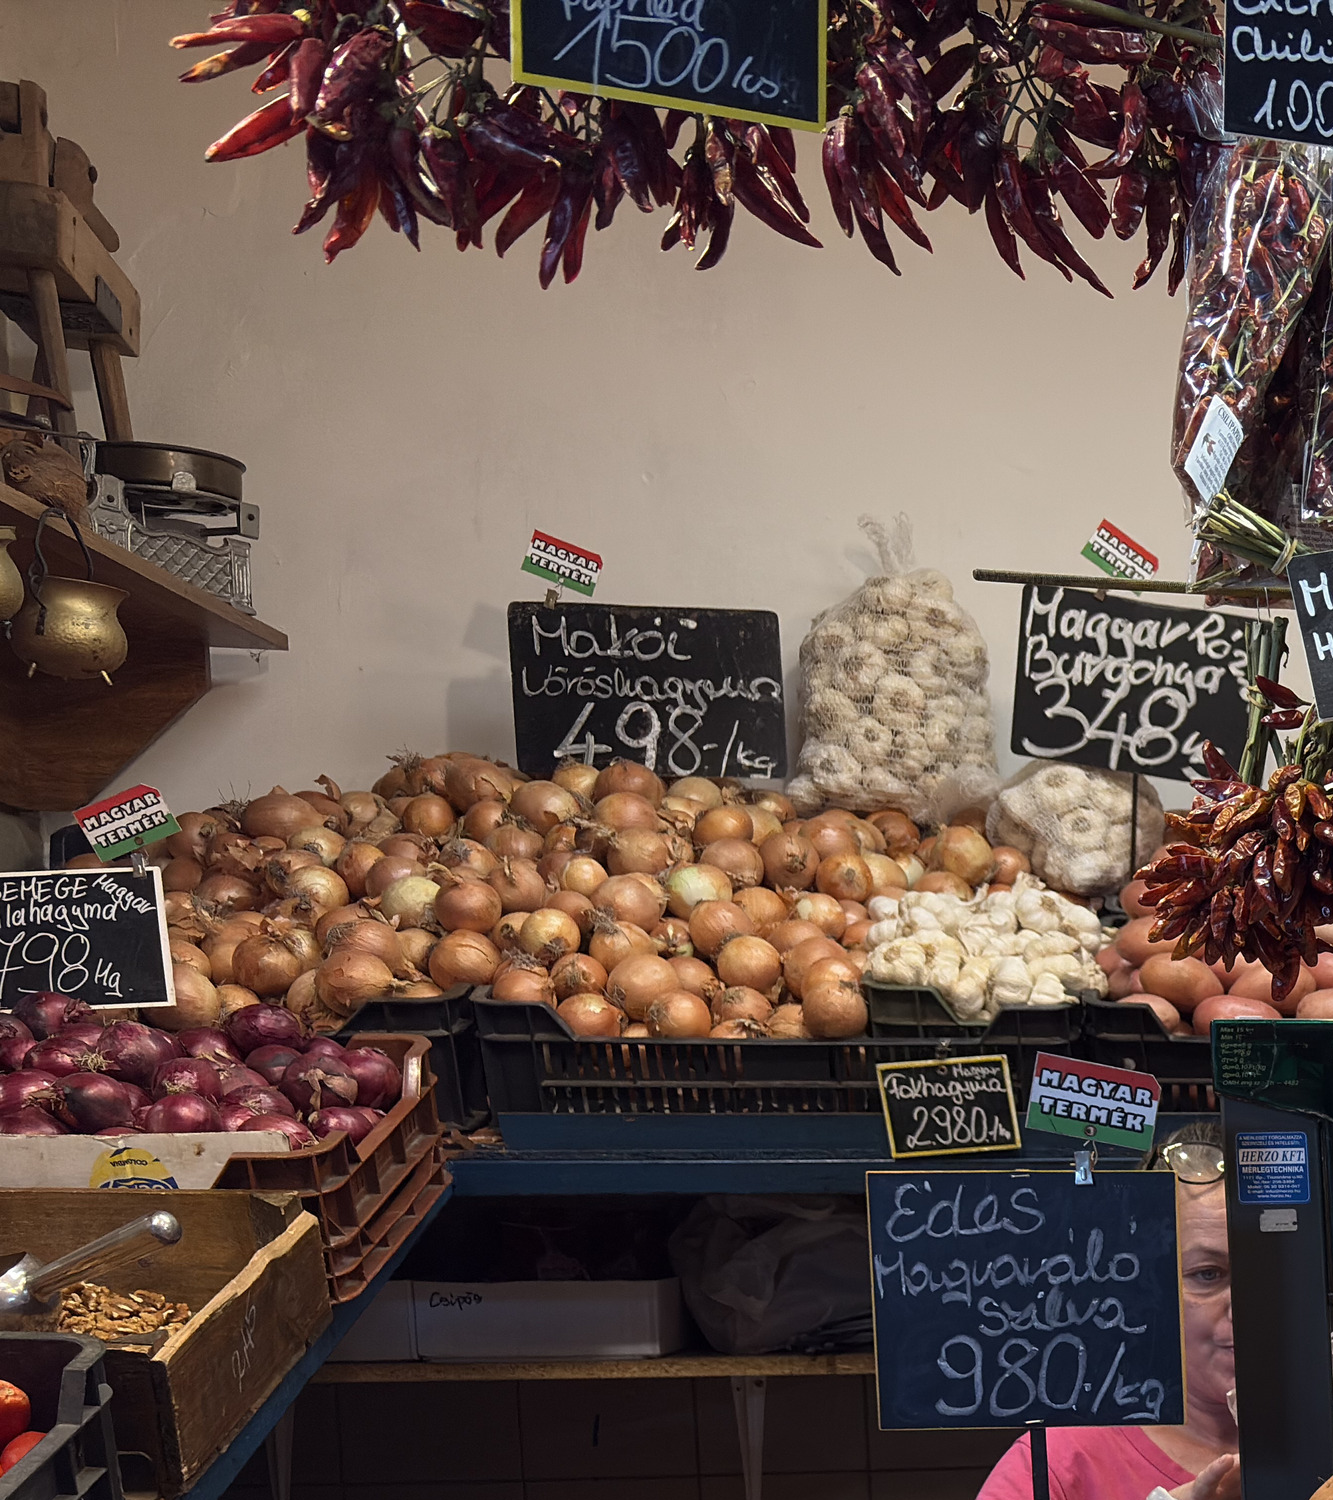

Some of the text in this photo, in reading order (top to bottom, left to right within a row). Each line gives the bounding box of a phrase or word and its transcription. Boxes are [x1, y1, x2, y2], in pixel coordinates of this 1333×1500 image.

[533, 538, 599, 572] MAGYAR
[1091, 541, 1145, 580] TERMÉK
[1098, 527, 1154, 574] MAGYAR
[530, 554, 592, 586] TERMÉK
[1026, 586, 1190, 663] Magyar
[83, 792, 160, 832] MAGYAR
[96, 810, 168, 848] TERMÉK
[0, 873, 156, 914] EMEGE Magyar
[0, 898, 117, 932] lahagyma
[1039, 1067, 1152, 1107] MAGYAR
[1040, 1096, 1145, 1132] TERMÉK
[1241, 1150, 1304, 1162] HERZO KFT.
